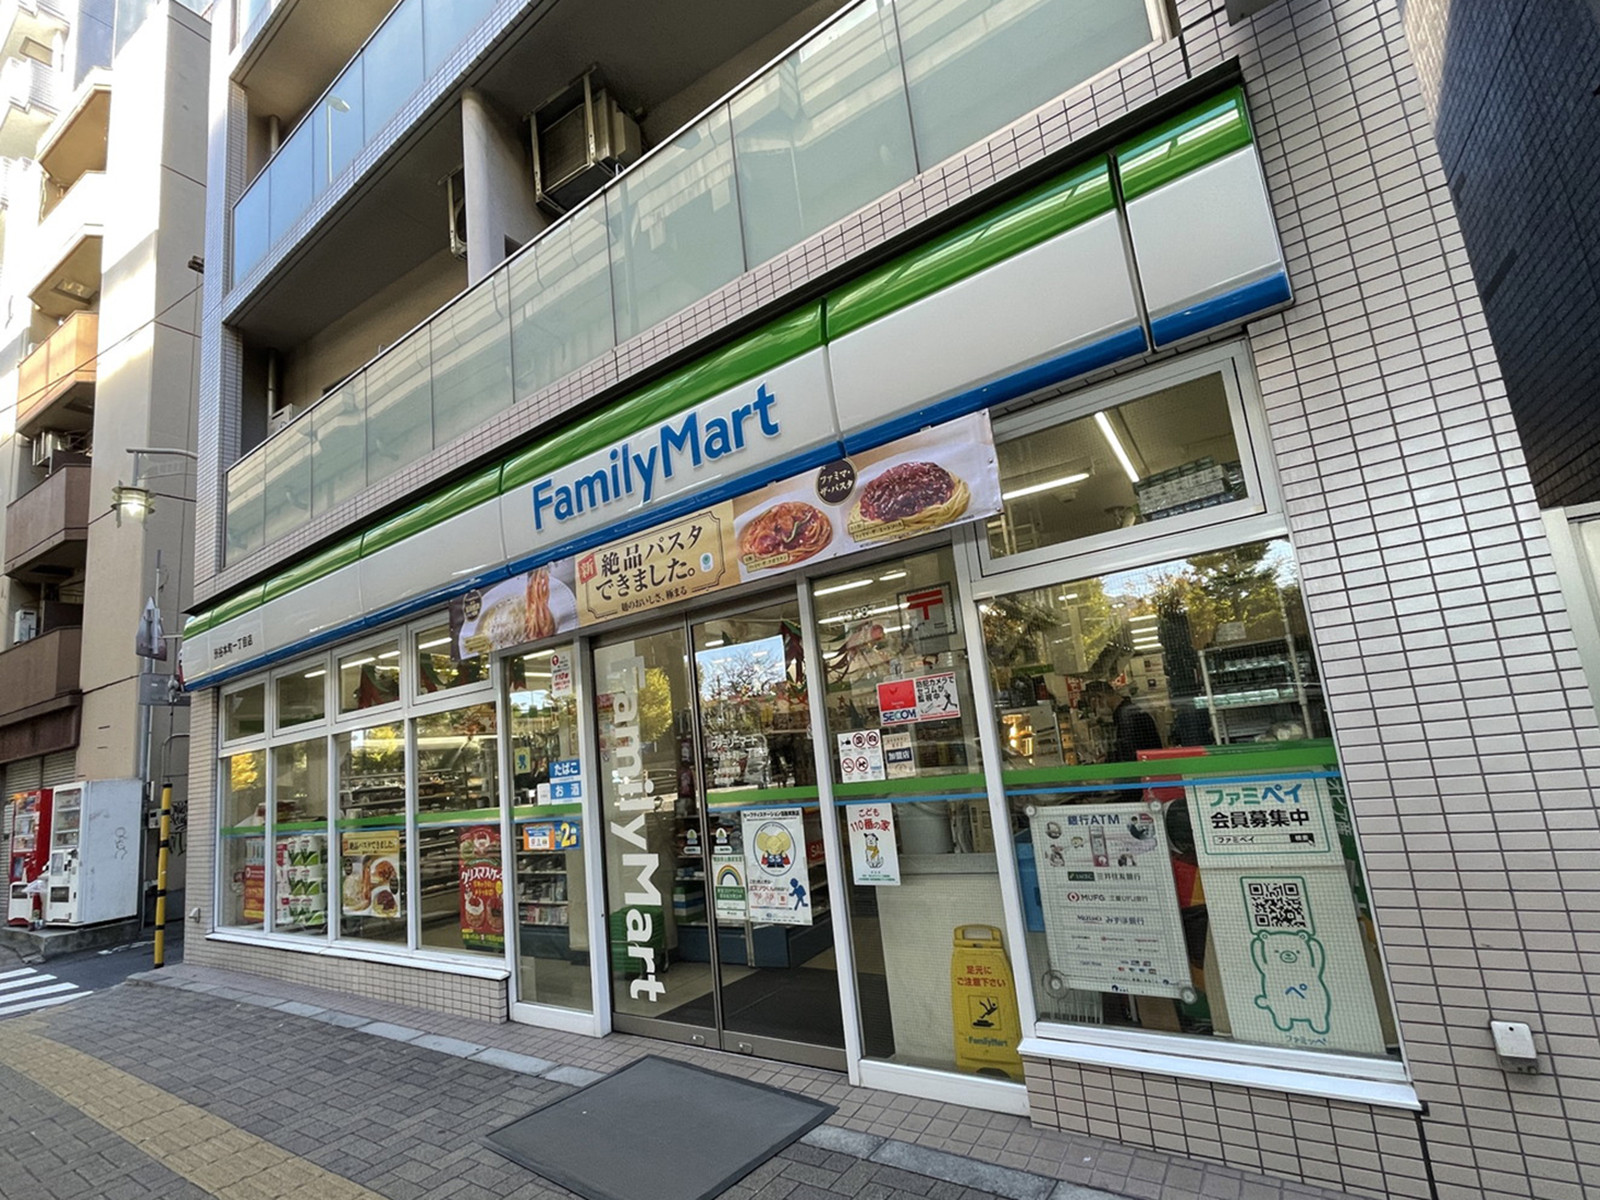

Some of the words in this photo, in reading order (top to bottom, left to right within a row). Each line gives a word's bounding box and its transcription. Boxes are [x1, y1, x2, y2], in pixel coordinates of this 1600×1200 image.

[532, 382, 780, 531] FamilyMart
[601, 525, 703, 578] 絶品パスタ
[595, 558, 696, 601] できました。
[621, 586, 688, 612] 麺のおいしさ、極まる
[916, 676, 955, 688] 防犯カメラで
[882, 709, 917, 722] SECOM
[554, 763, 578, 776] たばこ
[1205, 784, 1302, 807] ファミペイ
[858, 808, 880, 817] こども
[1210, 808, 1310, 829] 会員募集中
[850, 818, 891, 833] 110番の家
[1067, 814, 1121, 826] 銀行ATM
[610, 655, 666, 1002] FamilyMart
[1081, 894, 1106, 902] MUFG
[966, 965, 993, 975] 足元に
[957, 977, 1006, 987] ご注意下さい
[968, 1036, 1008, 1047] FamilyMart
